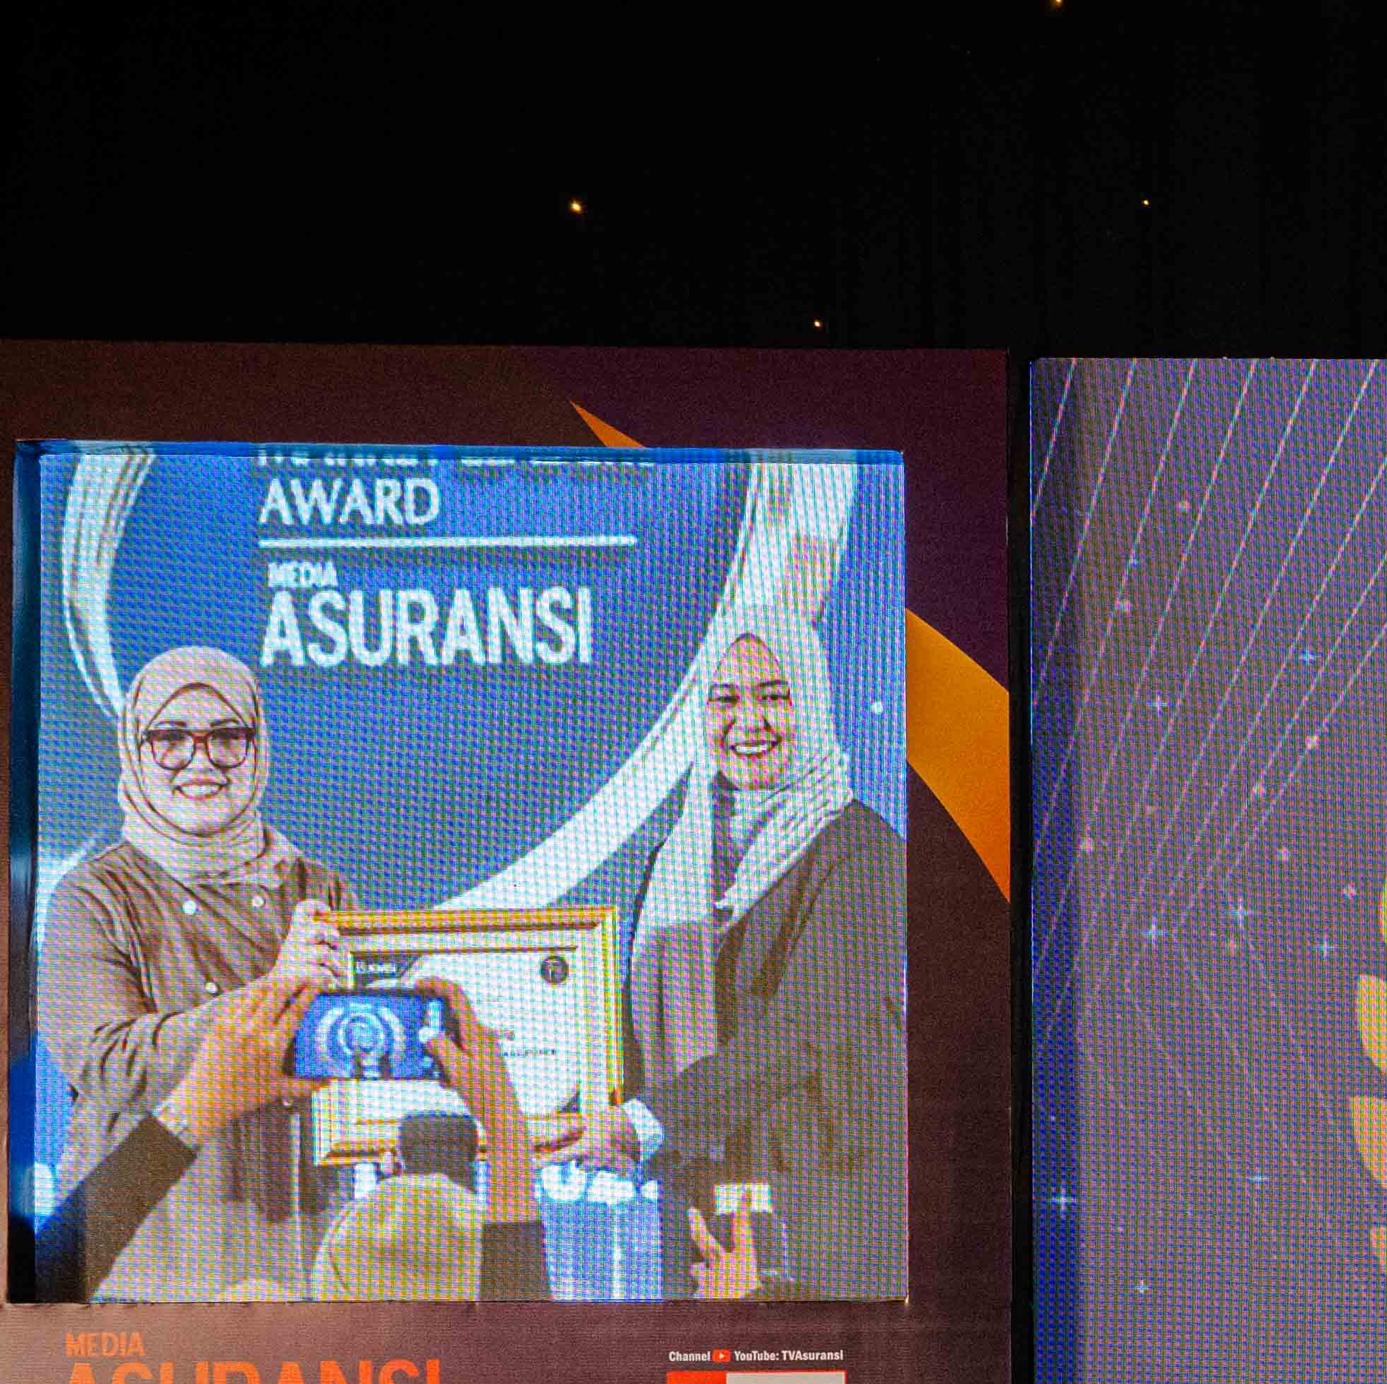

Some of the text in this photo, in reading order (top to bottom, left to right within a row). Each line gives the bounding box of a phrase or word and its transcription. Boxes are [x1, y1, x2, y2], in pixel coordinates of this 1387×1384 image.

[259, 478, 440, 525] AWARD
[267, 561, 338, 587] MEDIA
[260, 586, 592, 667] ASURANSI
[65, 1332, 145, 1358] MEDIA
[669, 1350, 844, 1362] Channel YouTube: TVAsuransi
